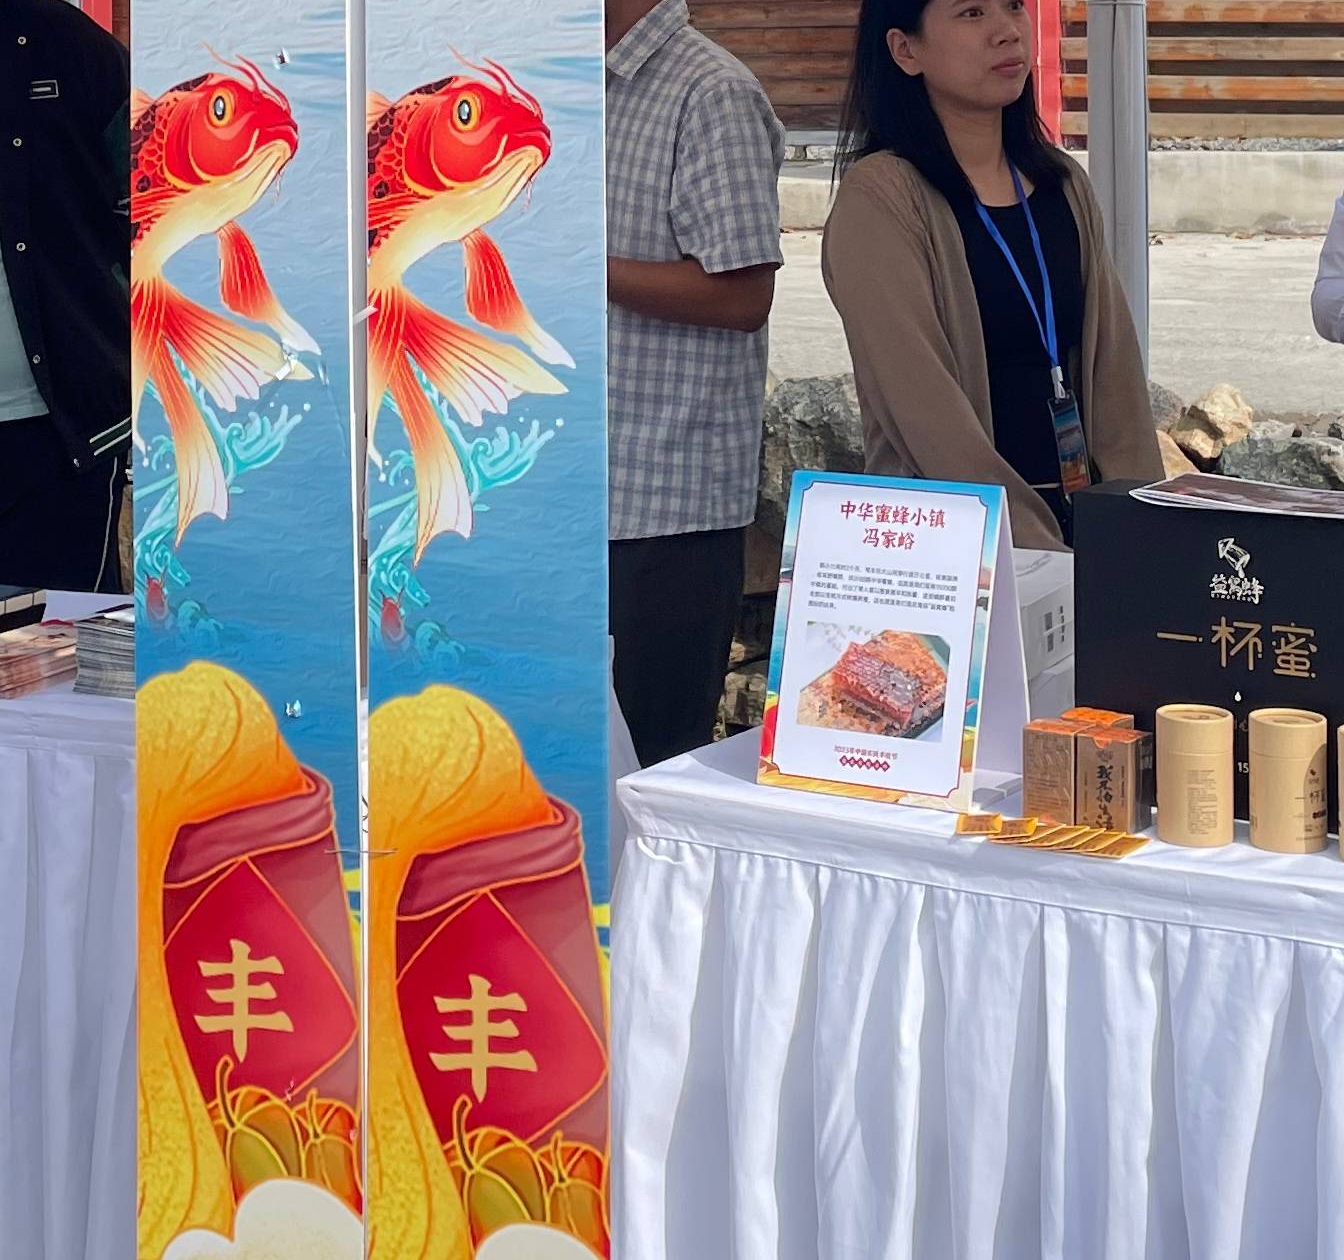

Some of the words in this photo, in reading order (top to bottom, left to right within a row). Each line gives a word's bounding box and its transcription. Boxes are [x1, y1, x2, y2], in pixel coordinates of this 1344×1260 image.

[840, 500, 945, 529] 中华蜜蜂小镇
[862, 527, 916, 550] 冯家峪
[1156, 615, 1319, 678] 一杯蜜
[193, 939, 294, 1063] 丰
[428, 973, 538, 1103] 丰
